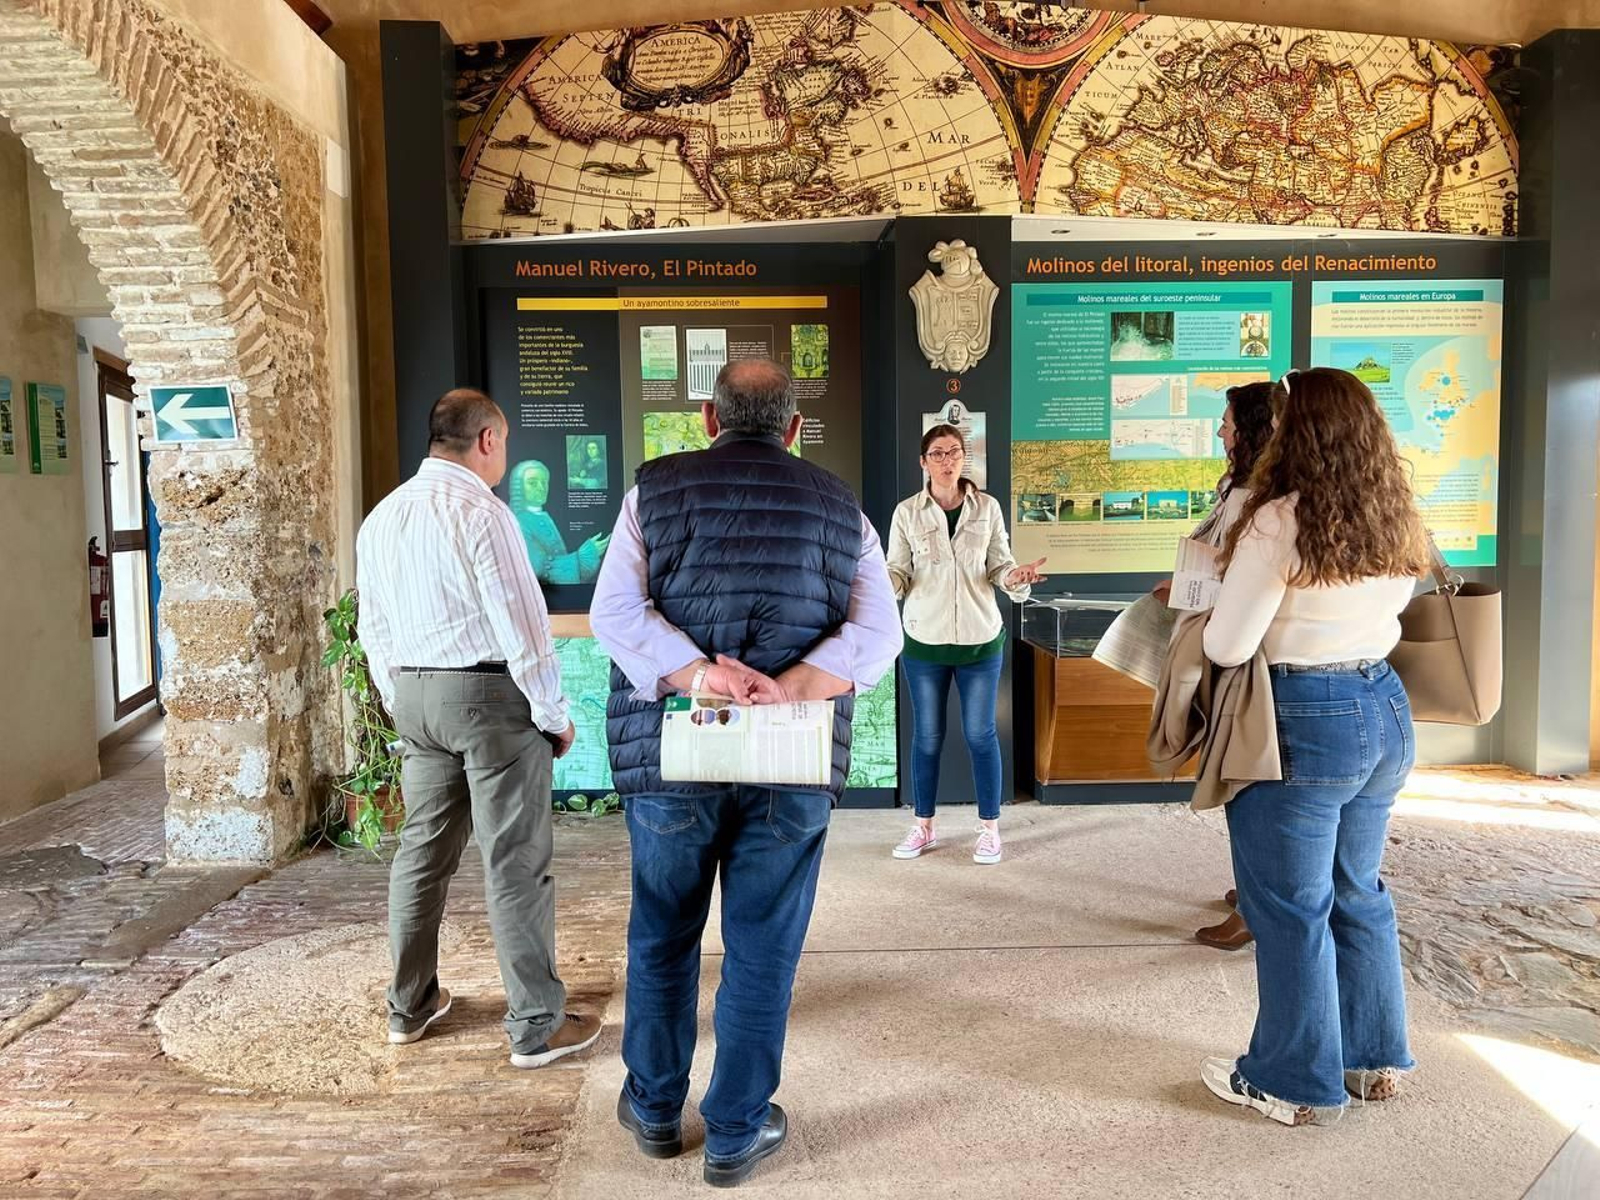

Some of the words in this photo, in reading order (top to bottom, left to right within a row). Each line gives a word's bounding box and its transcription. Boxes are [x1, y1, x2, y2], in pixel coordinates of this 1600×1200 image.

[651, 36, 701, 48] AMERICA
[549, 74, 602, 85] AMERICA
[927, 130, 971, 144] MAR
[902, 181, 940, 192] DEL
[515, 260, 583, 277] Manuel
[590, 260, 656, 279] Rivero,
[663, 259, 680, 277] El
[687, 259, 757, 277] Pintado
[1026, 257, 1095, 274] Molinos
[1101, 257, 1129, 273] del
[1135, 256, 1194, 275] litoral,
[1201, 256, 1275, 277] ingenios
[1281, 255, 1309, 272] del
[1315, 254, 1437, 271] Renacimiento
[1077, 294, 1104, 304] Molinos
[1105, 294, 1138, 303] mareales
[1140, 294, 1151, 303] del
[1153, 294, 1183, 303] suroeste
[1185, 293, 1221, 304] peninsular
[1360, 293, 1386, 301] Molinos
[1387, 292, 1420, 301] mareales
[1432, 291, 1456, 302] Europa
[623, 298, 634, 308] Un
[636, 298, 685, 310] ayamontino
[686, 297, 740, 308] sobresaliente
[950, 380, 958, 392] 3
